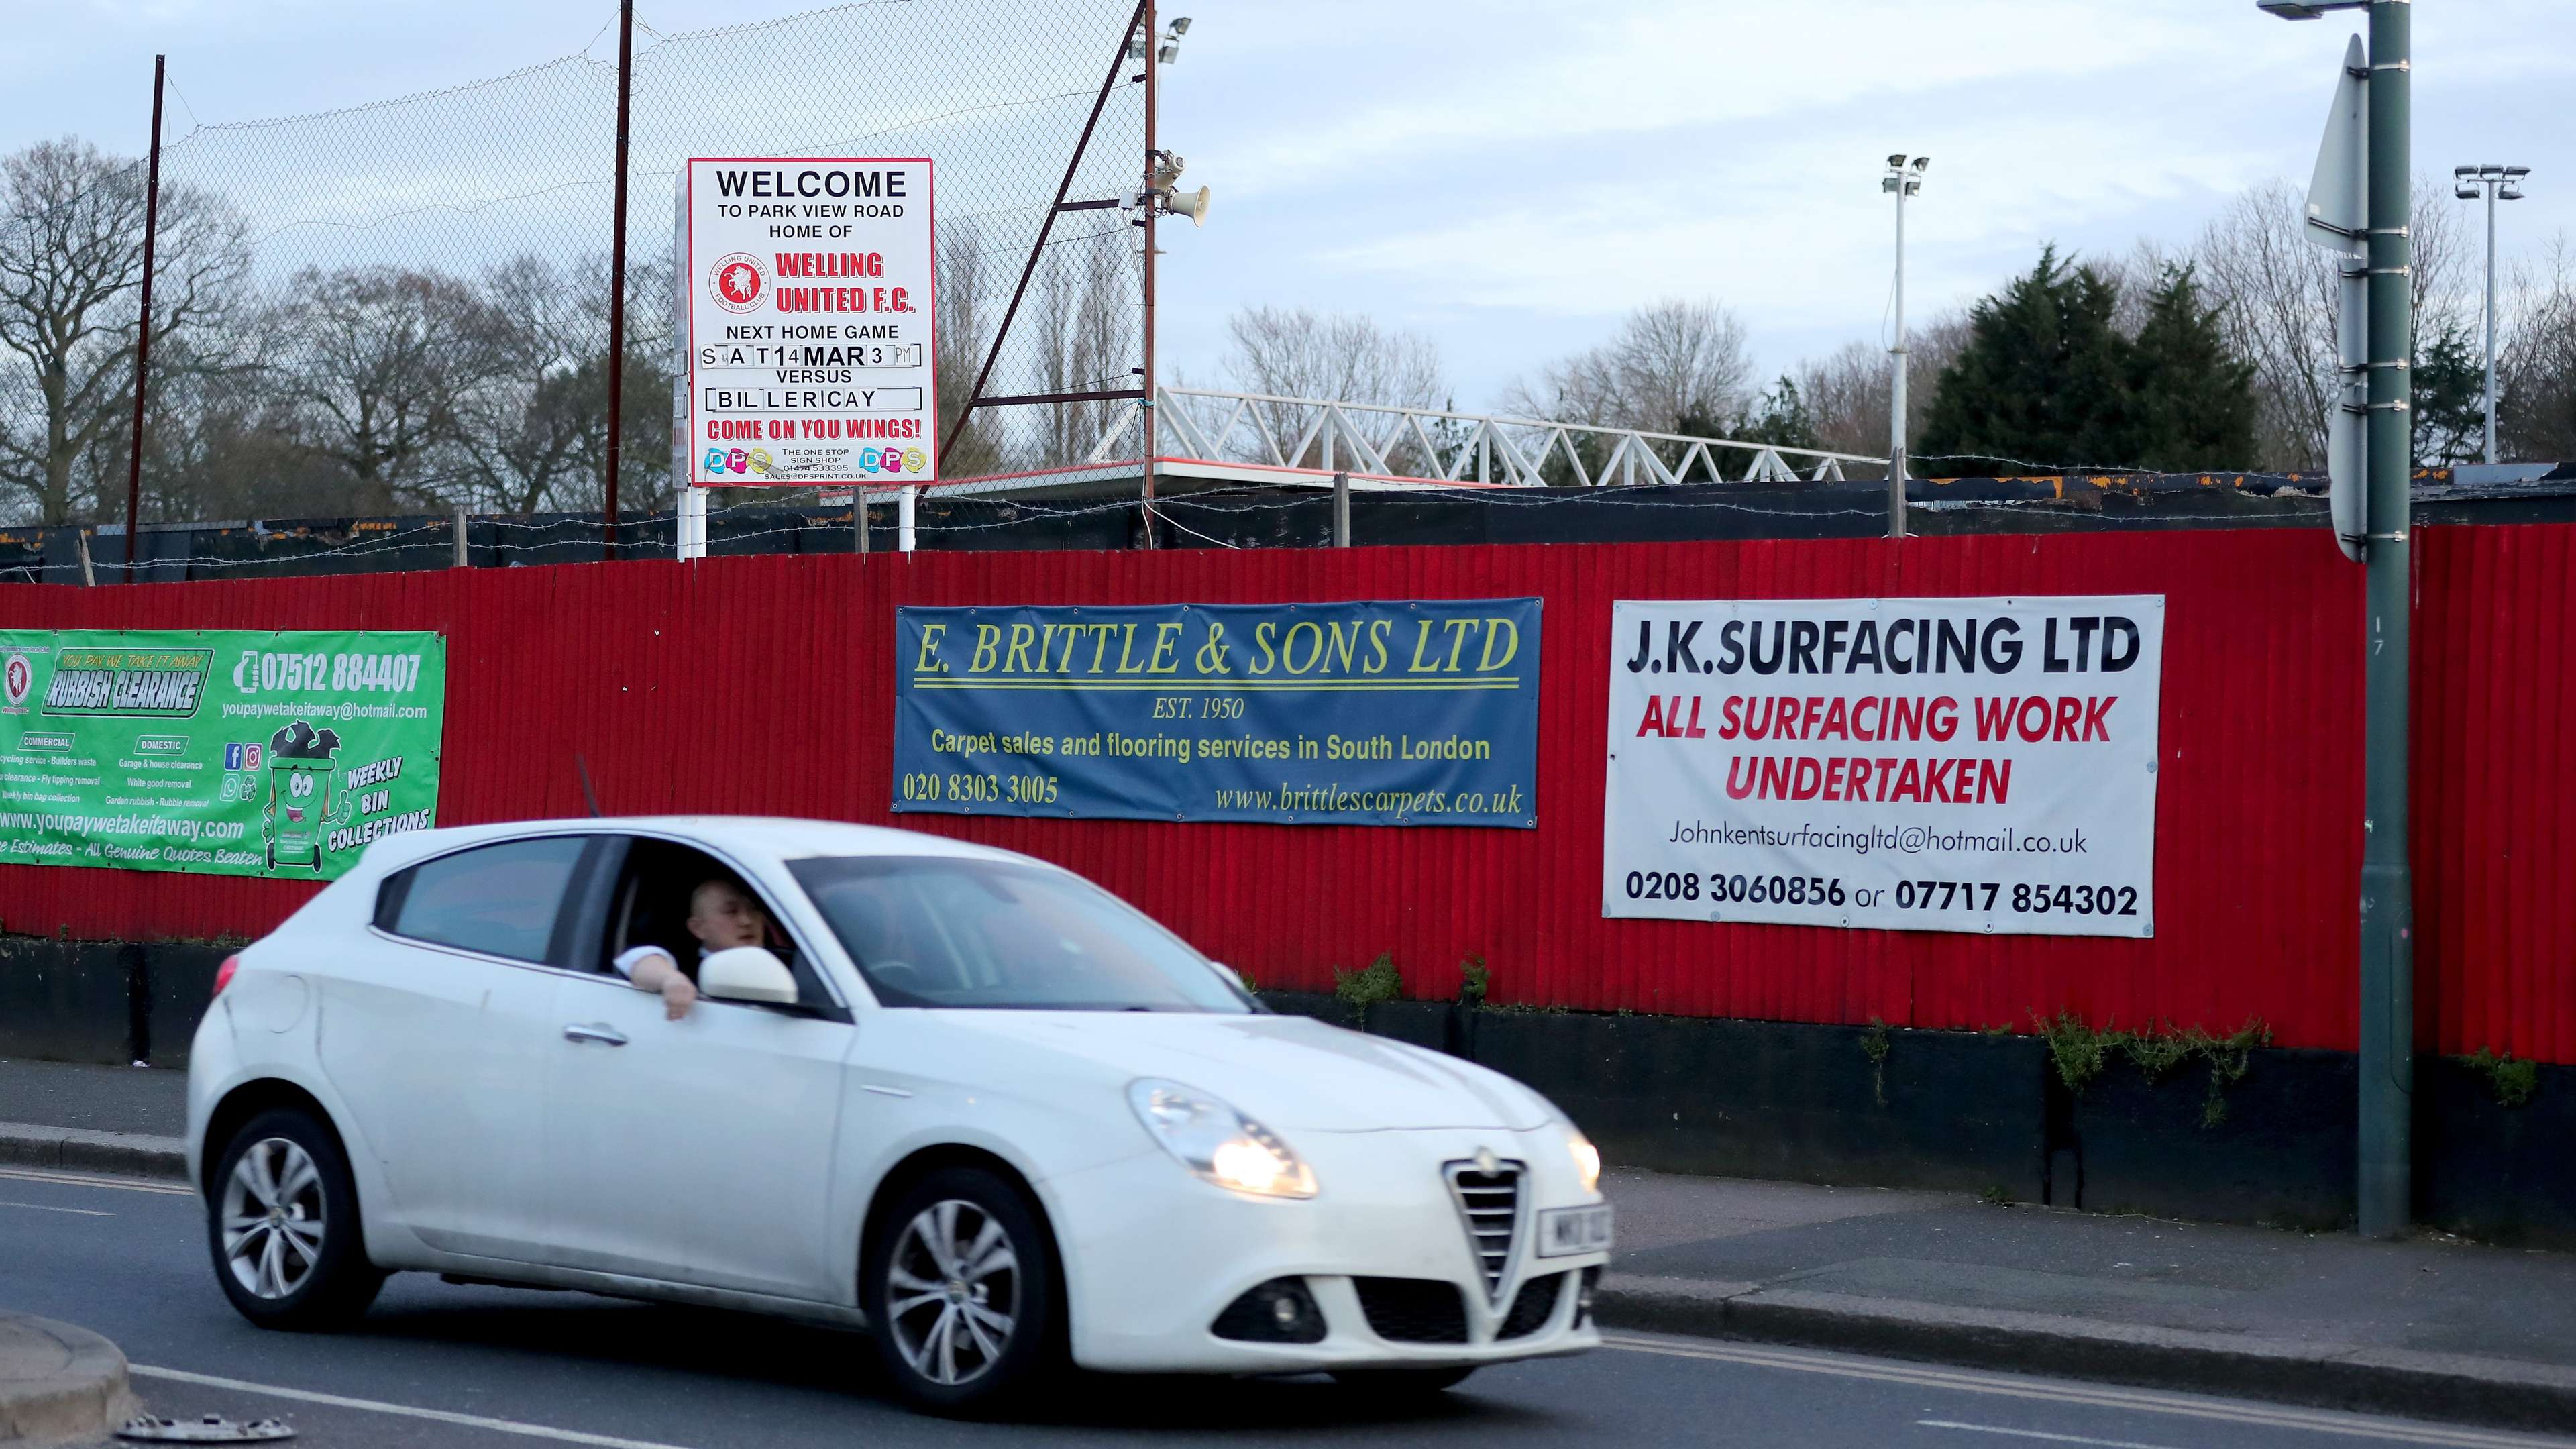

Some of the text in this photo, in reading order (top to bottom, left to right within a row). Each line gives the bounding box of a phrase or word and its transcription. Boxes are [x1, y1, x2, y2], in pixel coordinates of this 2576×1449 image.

[716, 171, 906, 197] WELCOME
[718, 205, 904, 218] TO PARK VIEW ROAD
[769, 225, 853, 238] HOME OF
[713, 256, 765, 276] WELLING UNITED
[775, 252, 885, 279] WELLING
[715, 292, 765, 311] FOOTBALL CLUB
[777, 286, 916, 313] UNITED F.C.
[727, 325, 900, 339] NEXT HOME GAME
[805, 346, 865, 366] MAR
[776, 370, 852, 384] VERSUS
[707, 418, 922, 441] COME ON YOU WINGS!
[782, 448, 801, 456] THE
[914, 618, 1519, 675] E. BRITTLE & SONS LTD
[1626, 616, 2141, 675] J.K.SURFACING LTD
[63, 655, 204, 669] YOU PAY WE TAKE IT AWAY
[262, 653, 421, 692] 07512 884407
[46, 669, 115, 709] RUBBISH
[113, 670, 201, 710] CLEARANCE
[222, 702, 427, 721] youpaywetakeitaway@hotmail.com
[1152, 698, 1244, 720] EST. 1950
[1636, 695, 2119, 743] ALL SURFACING WORK
[24, 737, 70, 747] COMMERCIAL
[142, 740, 181, 750] DOMESTIC
[932, 729, 1490, 764] Carpet sales and flooring services in South London
[78, 758, 97, 767] waste
[119, 759, 203, 770] Garage & house clearance
[347, 756, 403, 791] WEEKLY
[52, 775, 74, 786] tipping
[75, 776, 101, 786] removal
[127, 777, 191, 789] White good removal
[903, 773, 1058, 804] 020 8303 3005
[1725, 756, 2012, 804] UNDERTAKEN
[23, 792, 33, 800] bin
[34, 792, 47, 802] bag
[48, 793, 80, 803] collection
[105, 796, 128, 805] Garden
[129, 797, 154, 806] rubbish
[160, 798, 182, 806] Rubble
[183, 800, 209, 808] removal
[361, 789, 389, 815] BIN
[1216, 783, 1523, 819] www.brittlescarpets.co.uk
[0, 812, 244, 842] www.youpaywetakeitaway.com
[328, 808, 430, 853] COLLECTIONS
[1670, 820, 2088, 855] Johnkentsurfacingltd@hotmail.co.uk
[10, 839, 72, 855] Estimates
[85, 843, 103, 857] All
[105, 843, 160, 860] Genuine
[163, 846, 212, 863] Quotes
[215, 849, 264, 866] Beaten
[1626, 871, 2137, 916] 0208 3060856 or 07717 854302
